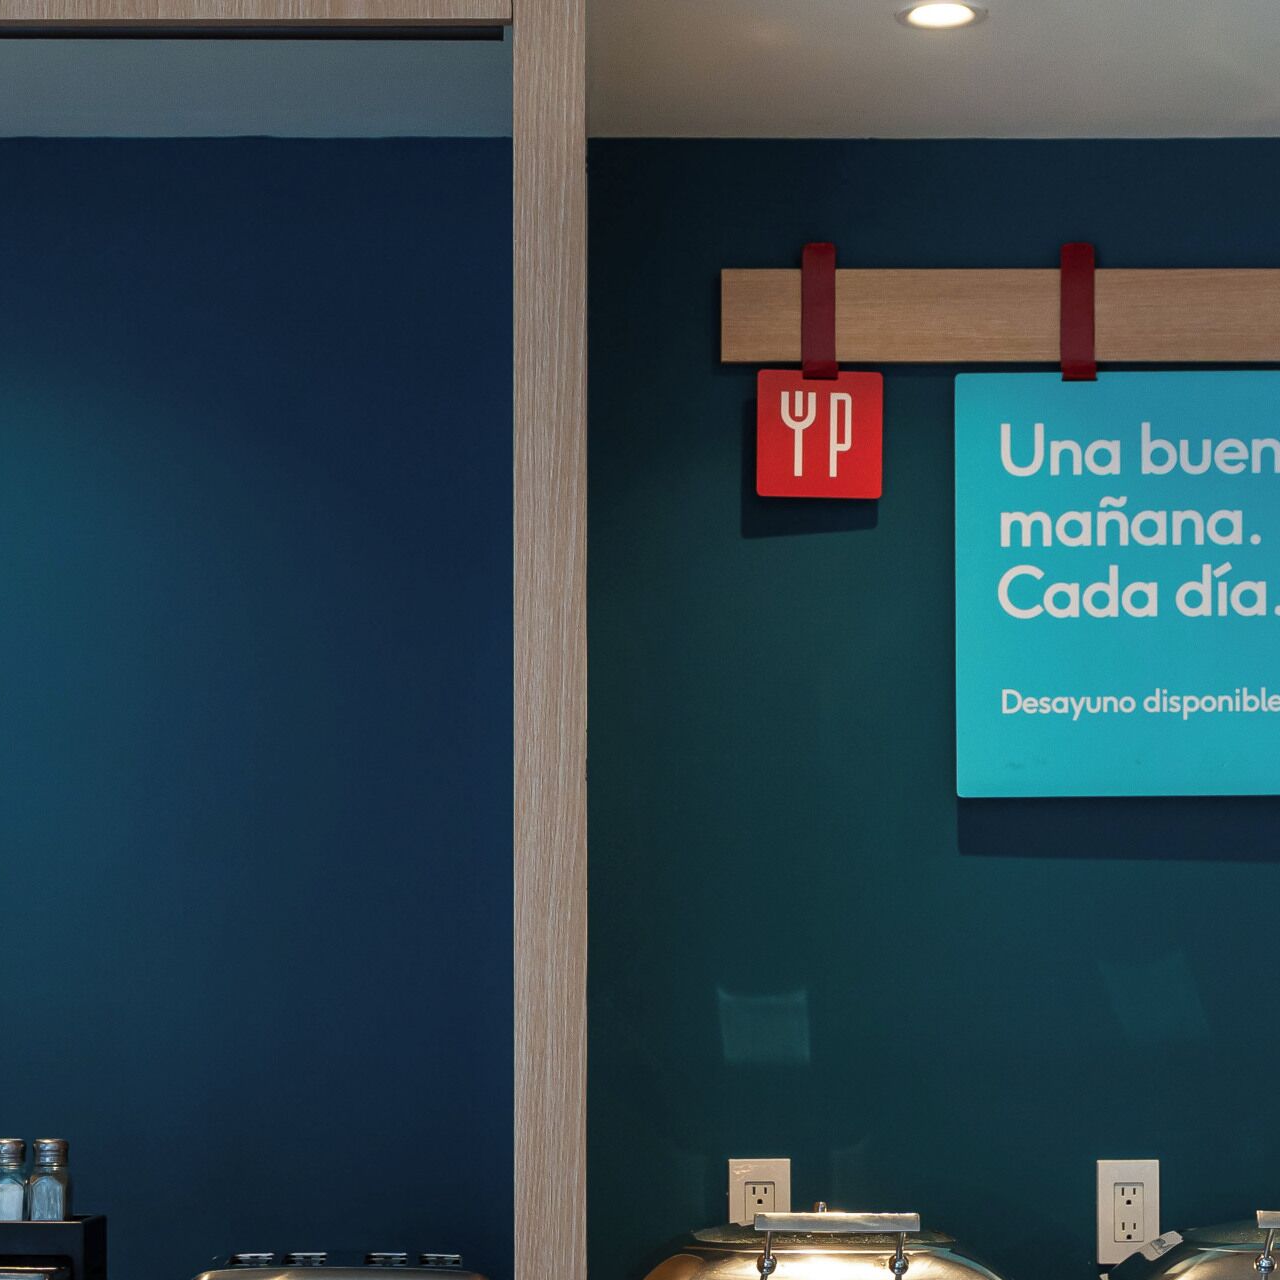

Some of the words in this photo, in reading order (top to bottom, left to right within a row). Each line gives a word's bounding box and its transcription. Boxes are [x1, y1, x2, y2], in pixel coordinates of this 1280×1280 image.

[1000, 423, 1121, 476] Una
[1000, 496, 1262, 547] mañana.
[998, 564, 1158, 619] Cada
[1001, 689, 1136, 721] Desayuno
